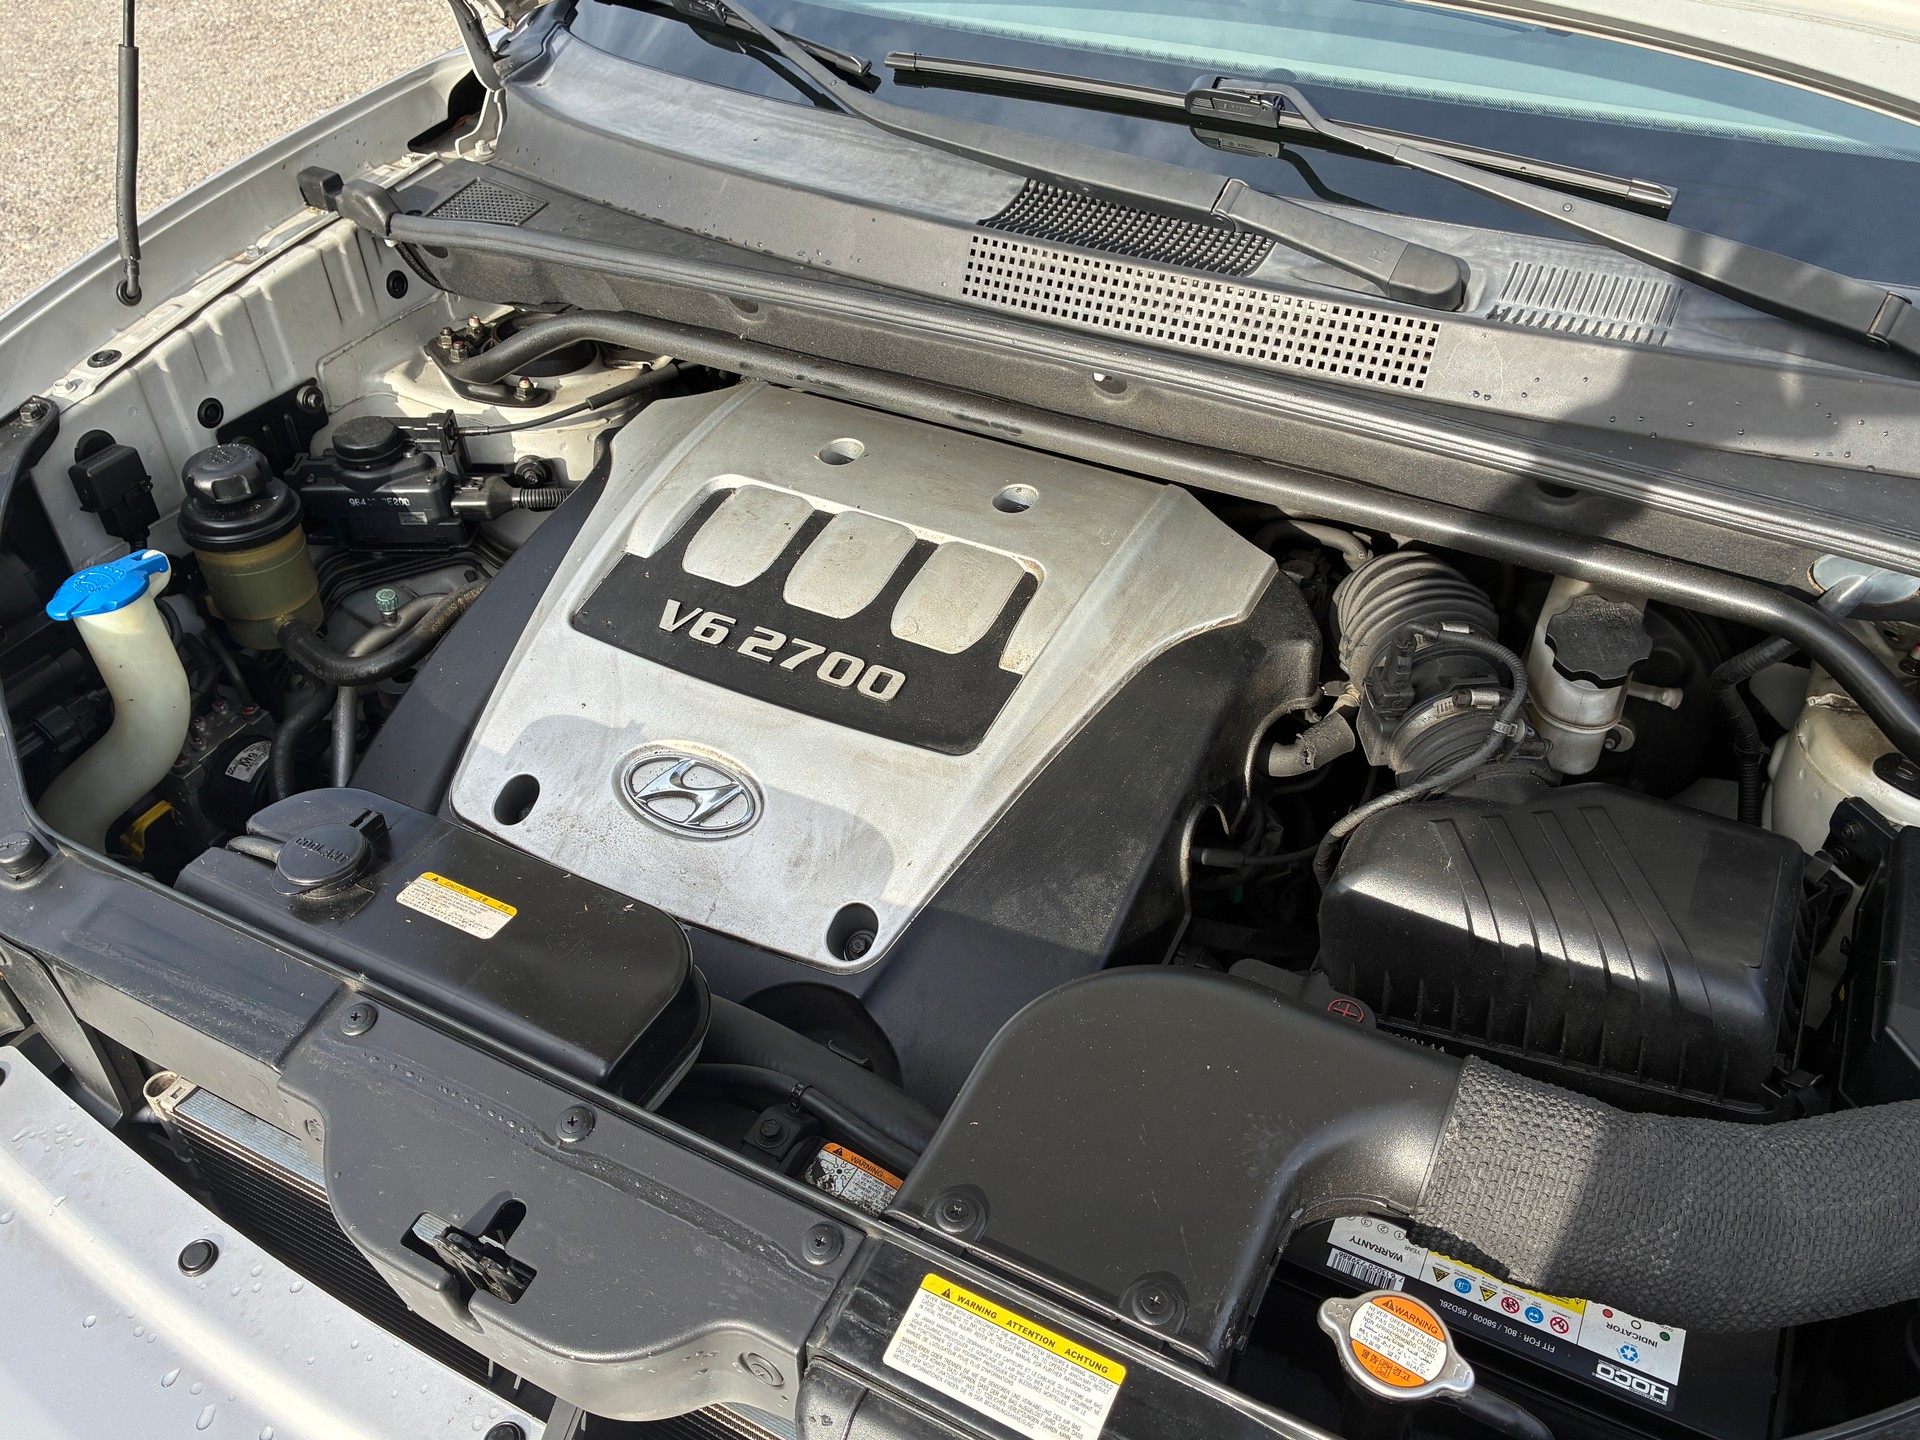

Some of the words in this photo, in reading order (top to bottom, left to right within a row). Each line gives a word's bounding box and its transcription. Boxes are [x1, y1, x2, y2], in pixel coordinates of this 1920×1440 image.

[659, 599, 736, 645] V6
[737, 626, 906, 702] 2700
[445, 881, 470, 895] CAUTION
[850, 1155, 884, 1178] WARNING
[1349, 1235, 1403, 1262] WARRANTY
[1404, 1244, 1421, 1255] YEAR
[1439, 1299, 1467, 1316] 85D26L
[1362, 1316, 1375, 1325] NON
[1365, 1310, 1375, 1318] NE
[1375, 1316, 1388, 1326] PAS
[1387, 1323, 1410, 1338] OUVRIR
[1368, 1305, 1388, 1319] NEVER
[1389, 1316, 1407, 1329] OPEN
[1406, 1326, 1426, 1340] WHEN
[1393, 1305, 1440, 1335] WARNING
[1473, 1314, 1497, 1330] 58009
[1503, 1326, 1518, 1337] 80L
[957, 1295, 997, 1319] WARNING
[1005, 1319, 1056, 1348] ATTENTION
[1064, 1348, 1109, 1374] ACHTUNG
[1524, 1334, 1541, 1347] FOR
[1606, 1322, 1658, 1348] INDICATOR
[1541, 1342, 1555, 1353] FIT
[1596, 1363, 1668, 1402] HOCO
